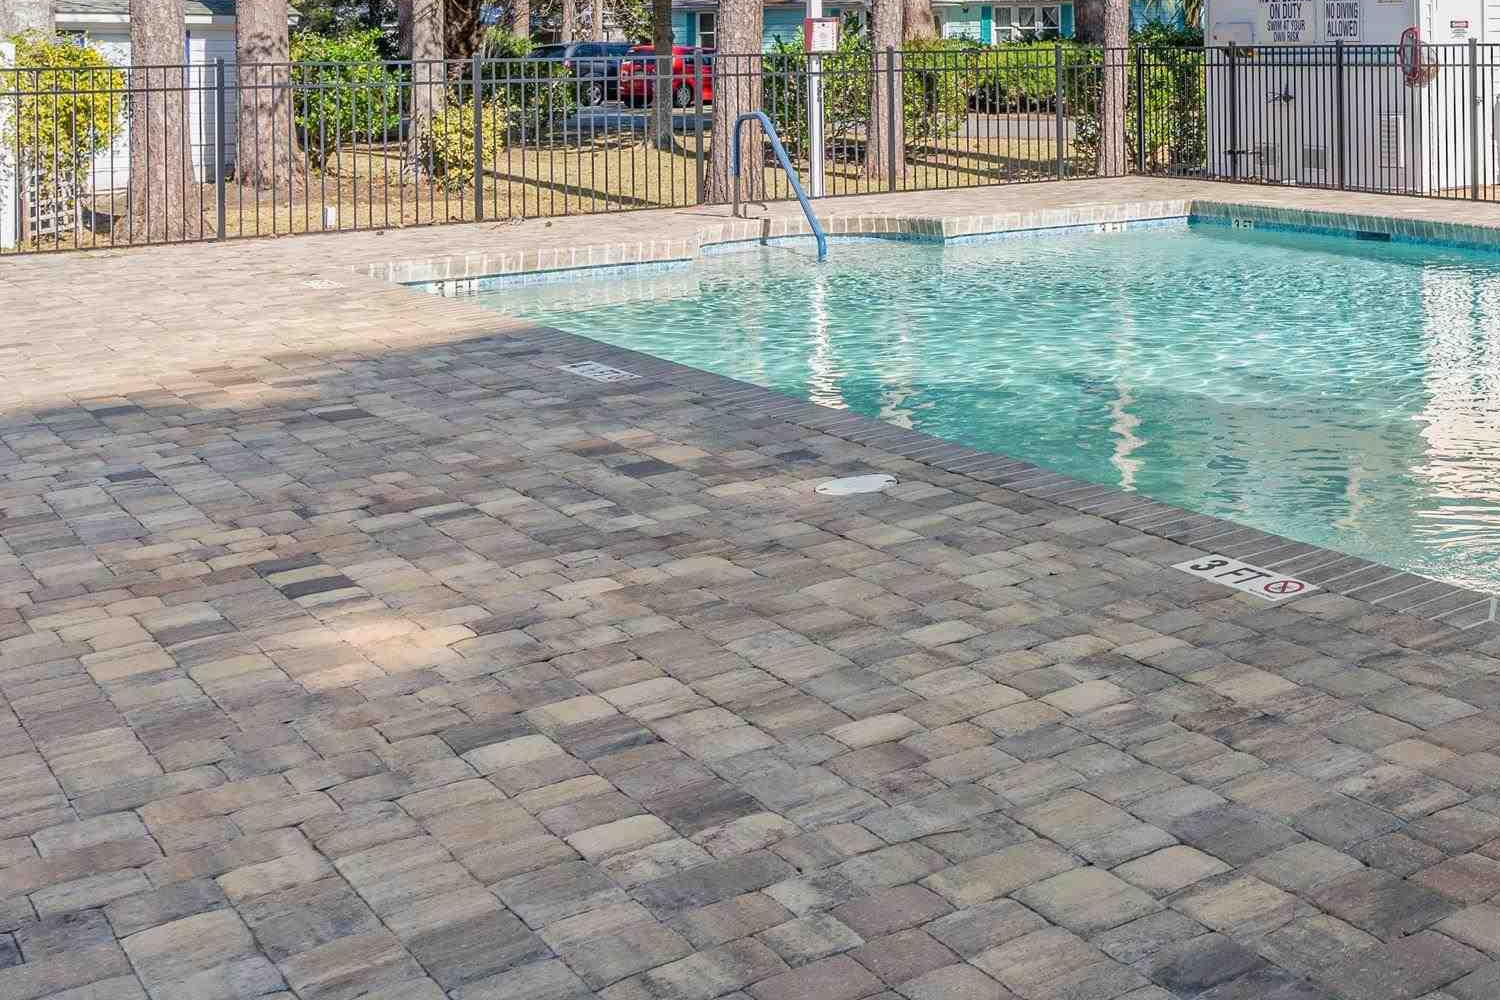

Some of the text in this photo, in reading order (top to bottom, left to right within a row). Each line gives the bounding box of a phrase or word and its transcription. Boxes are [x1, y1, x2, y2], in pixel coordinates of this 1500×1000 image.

[1270, 1, 1302, 19] ON DUTY
[1326, 2, 1359, 18] NO DIVING
[1287, 31, 1300, 41] RISK
[1327, 20, 1358, 37] ALLOWED
[1189, 559, 1273, 584] 3 FT
